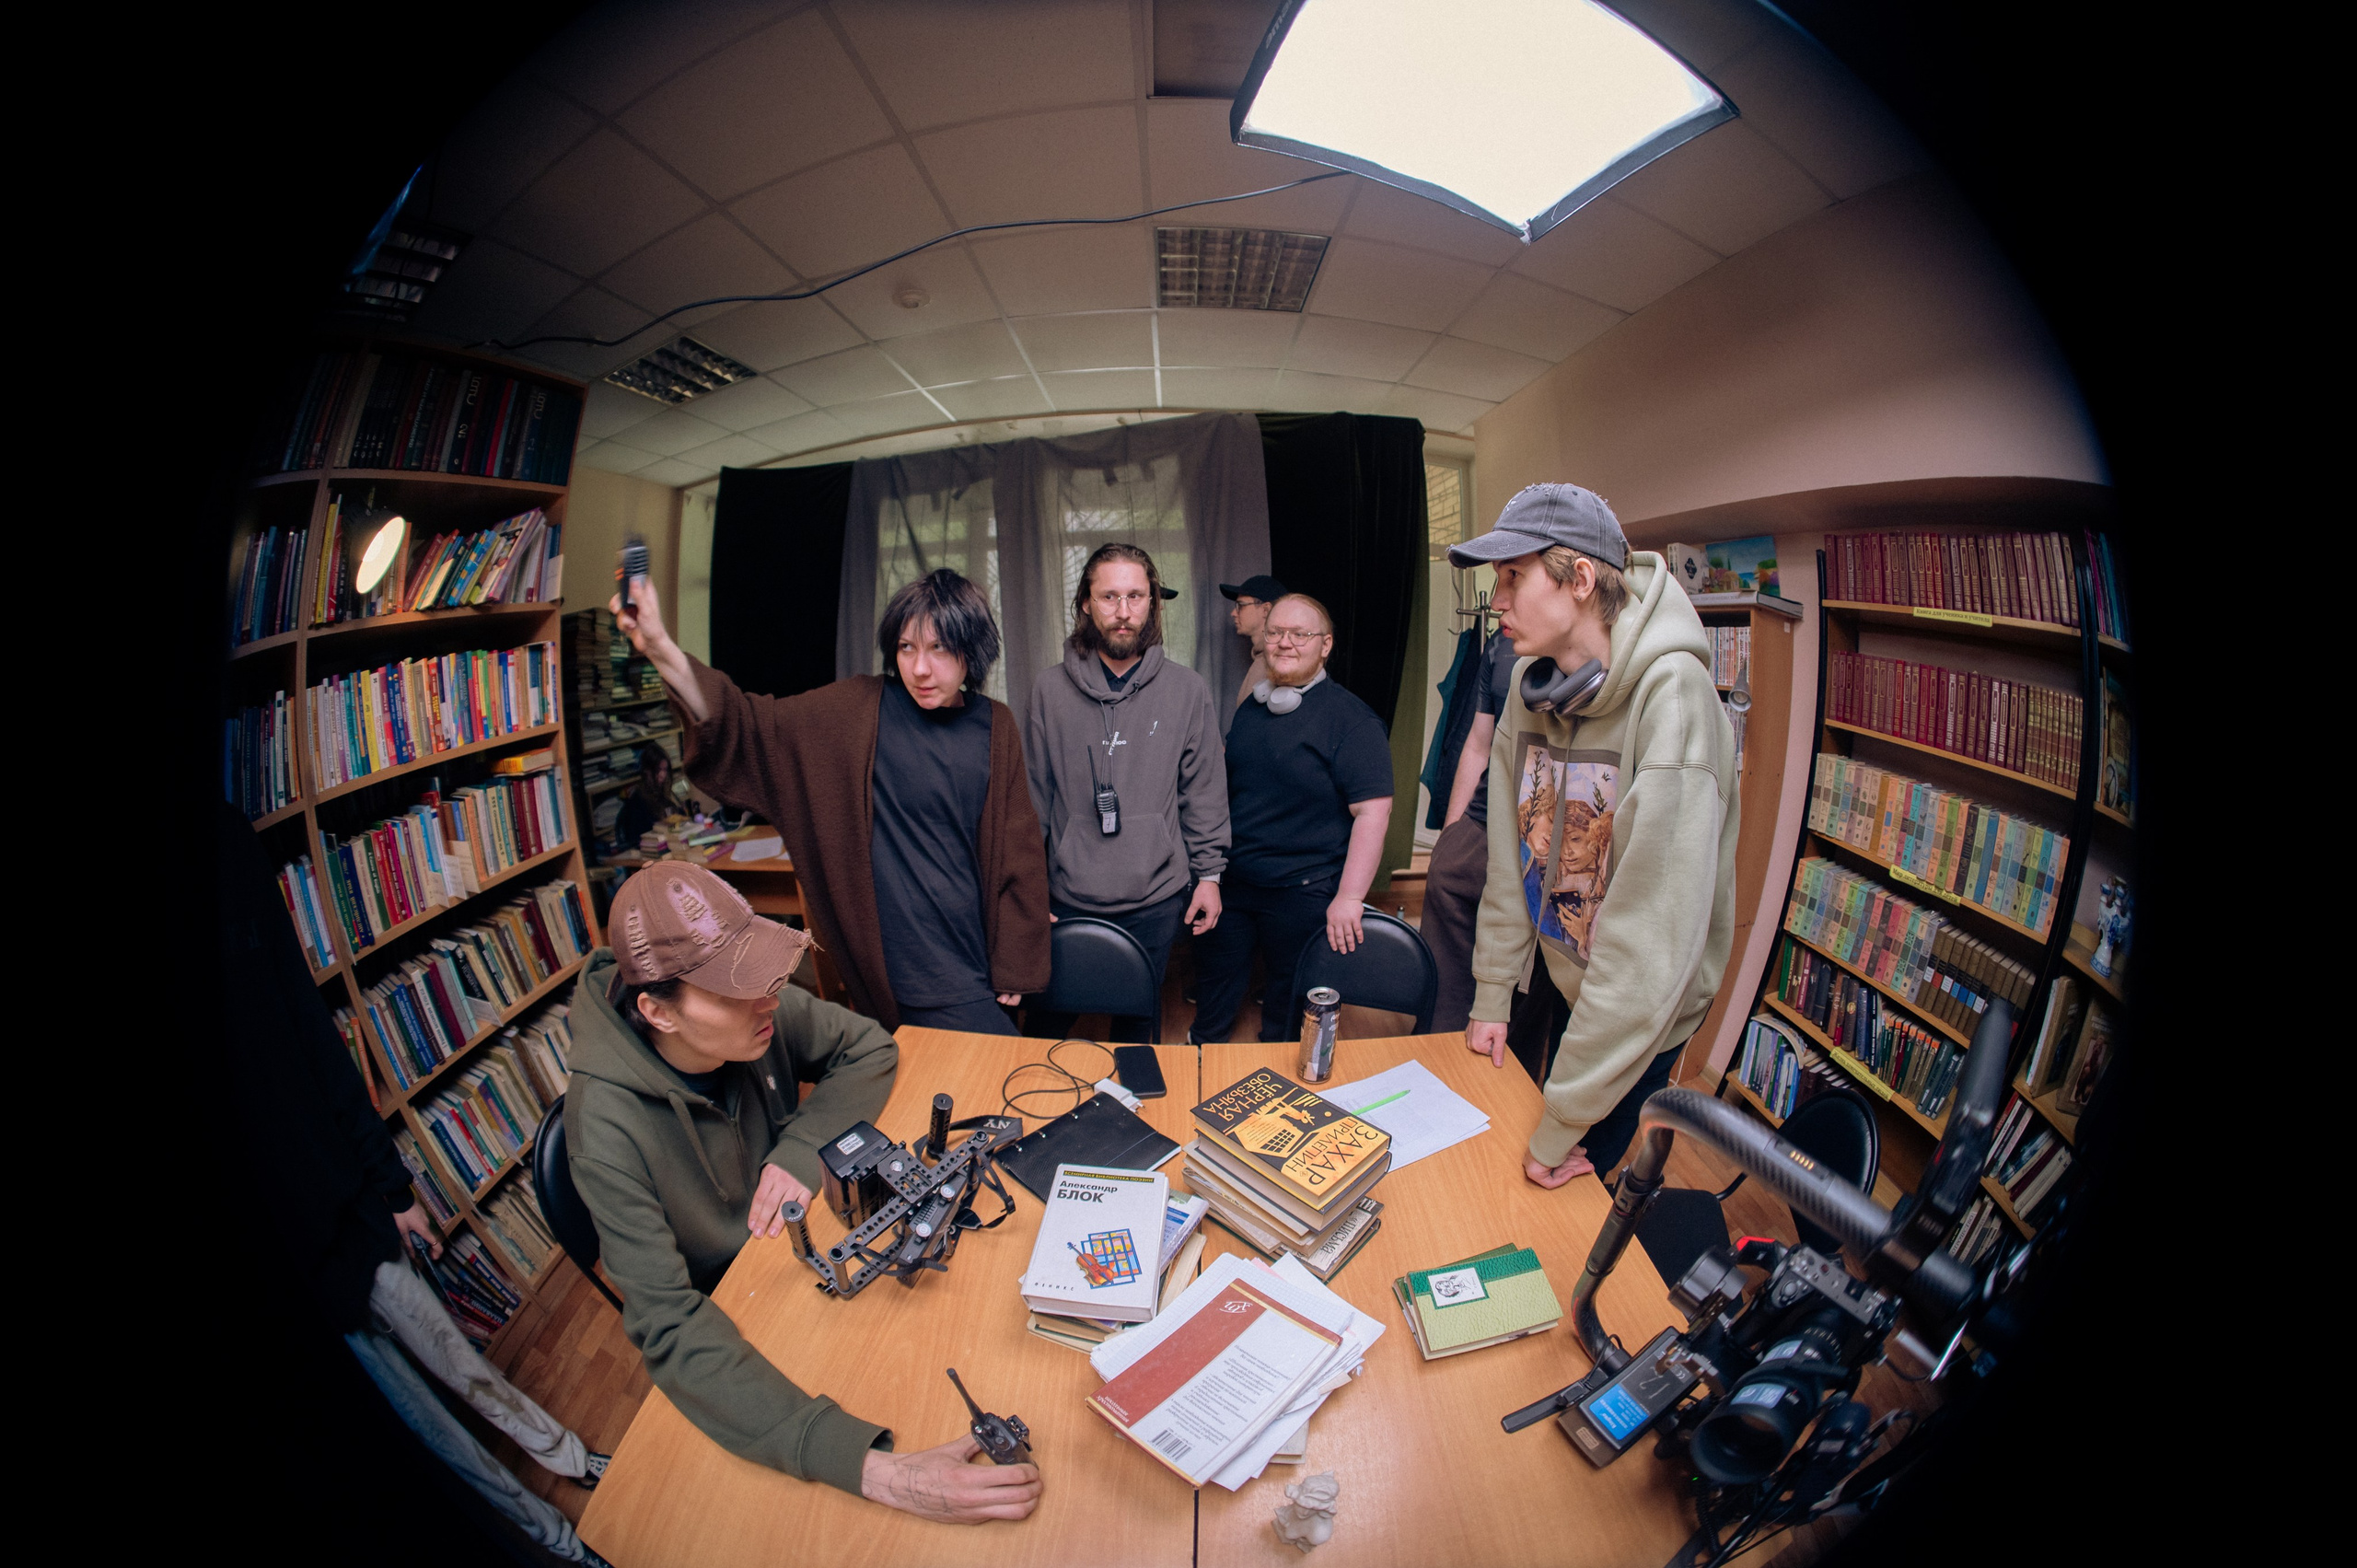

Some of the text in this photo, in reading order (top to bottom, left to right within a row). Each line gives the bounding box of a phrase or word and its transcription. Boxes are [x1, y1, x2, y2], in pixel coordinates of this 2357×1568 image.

[1202, 1073, 1271, 1113] ОБЕЗЬЯНА
[1217, 1084, 1283, 1121] ЧЁРНАЯ
[1285, 1118, 1359, 1173] ПРИЛЕПИН
[1307, 1125, 1378, 1186] ЗАХАР
[1057, 1189, 1105, 1203] БЛОК
[1060, 1180, 1118, 1193] Александр
